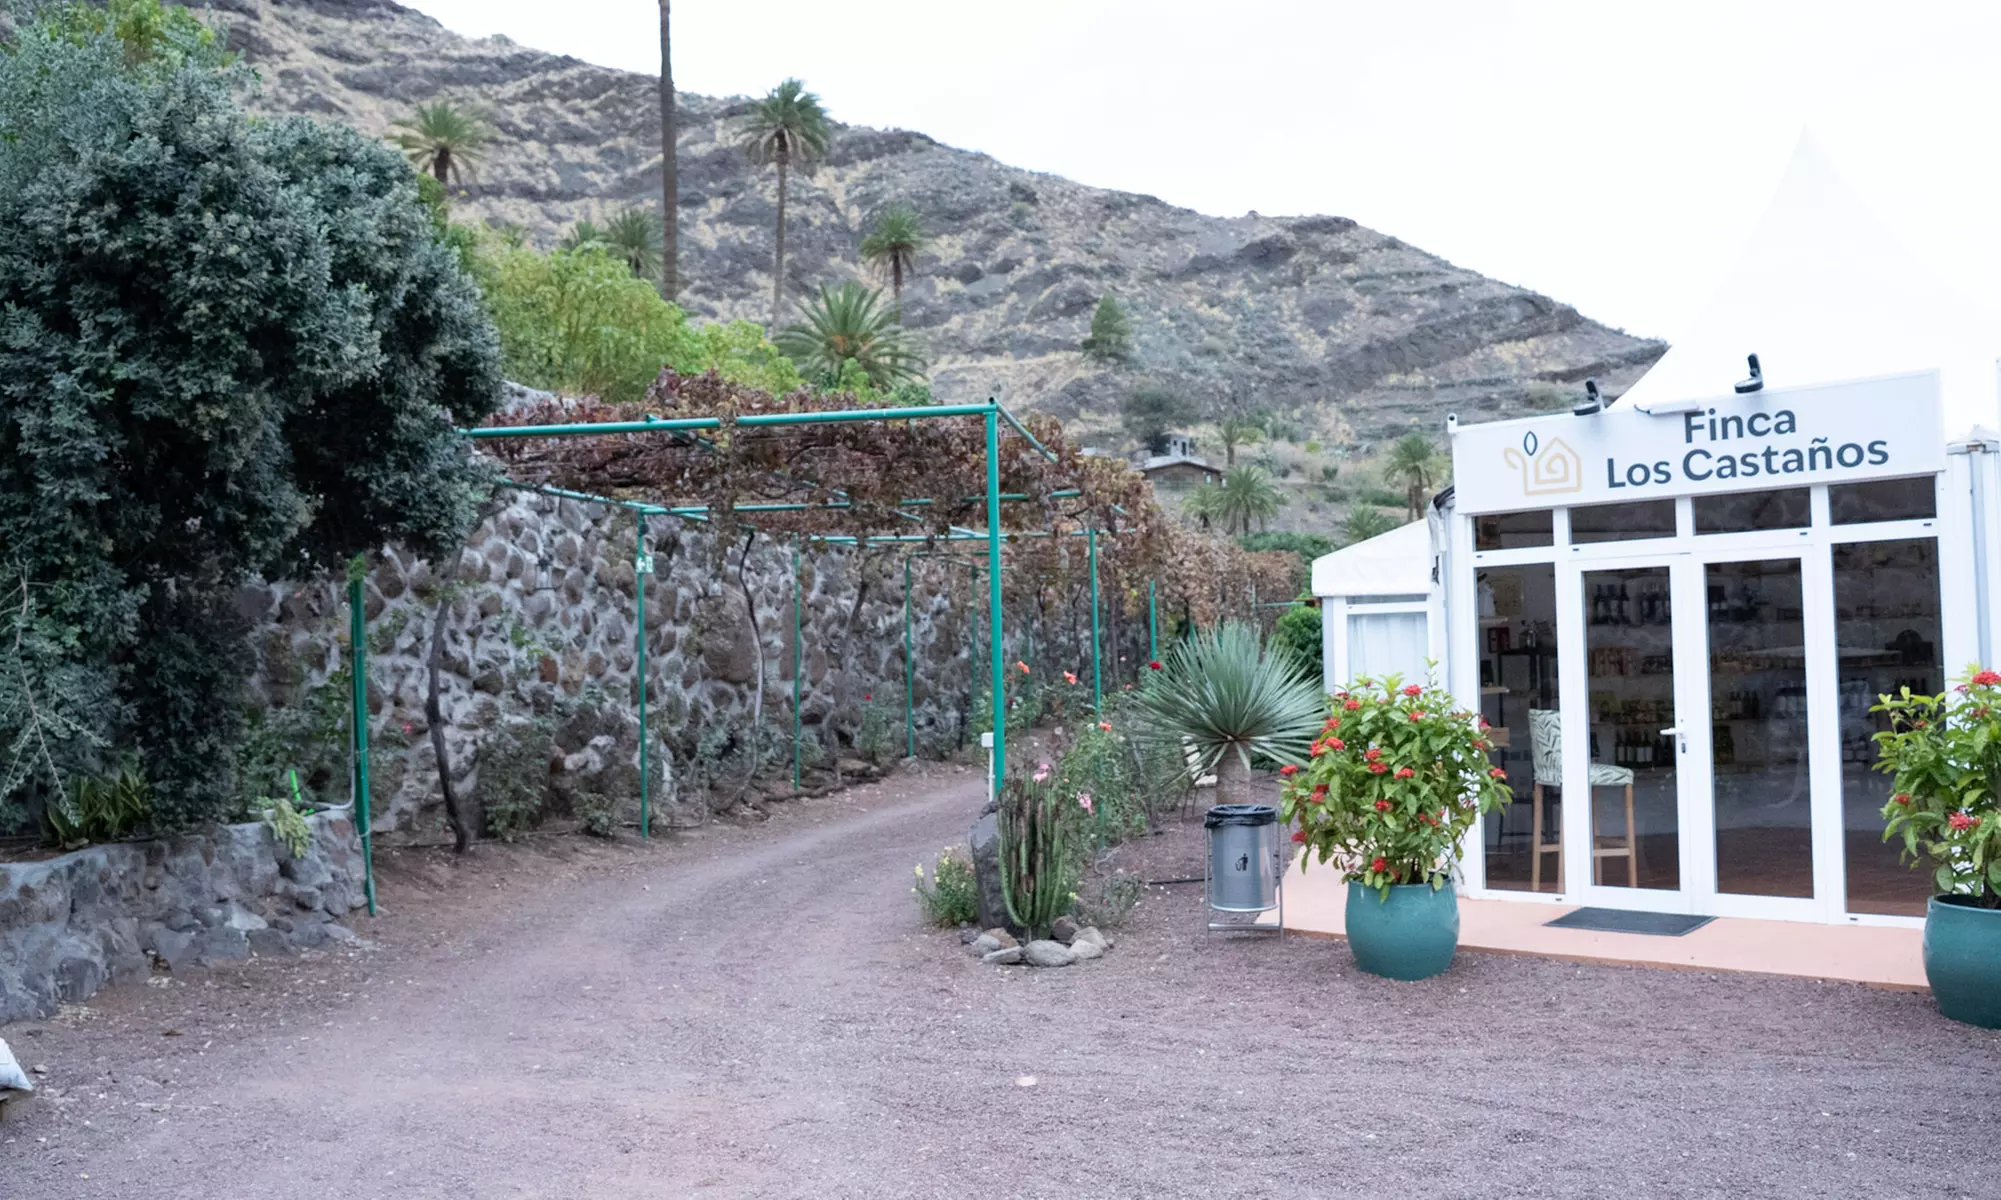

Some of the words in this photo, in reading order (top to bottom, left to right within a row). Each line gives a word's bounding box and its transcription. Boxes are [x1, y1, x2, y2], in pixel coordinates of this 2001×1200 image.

[1684, 408, 1797, 443] Finca
[1607, 457, 1672, 488] Los
[1682, 437, 1889, 481] Castaños
